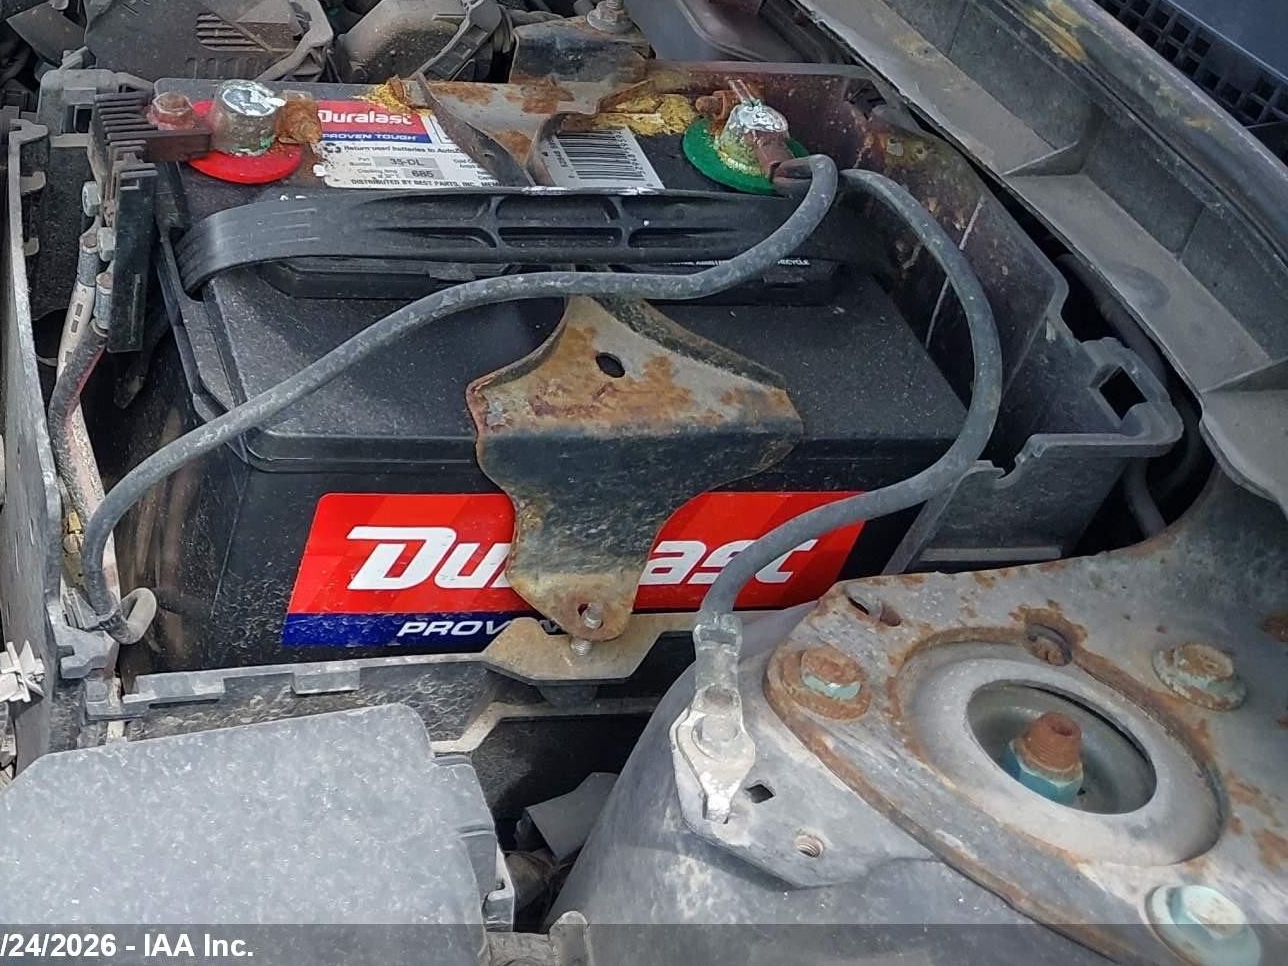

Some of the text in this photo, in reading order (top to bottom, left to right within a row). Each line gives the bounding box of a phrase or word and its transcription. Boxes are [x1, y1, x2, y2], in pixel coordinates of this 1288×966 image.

[318, 110, 412, 125] Duralast
[389, 158, 424, 166] 35-DL
[412, 170, 434, 178] 685
